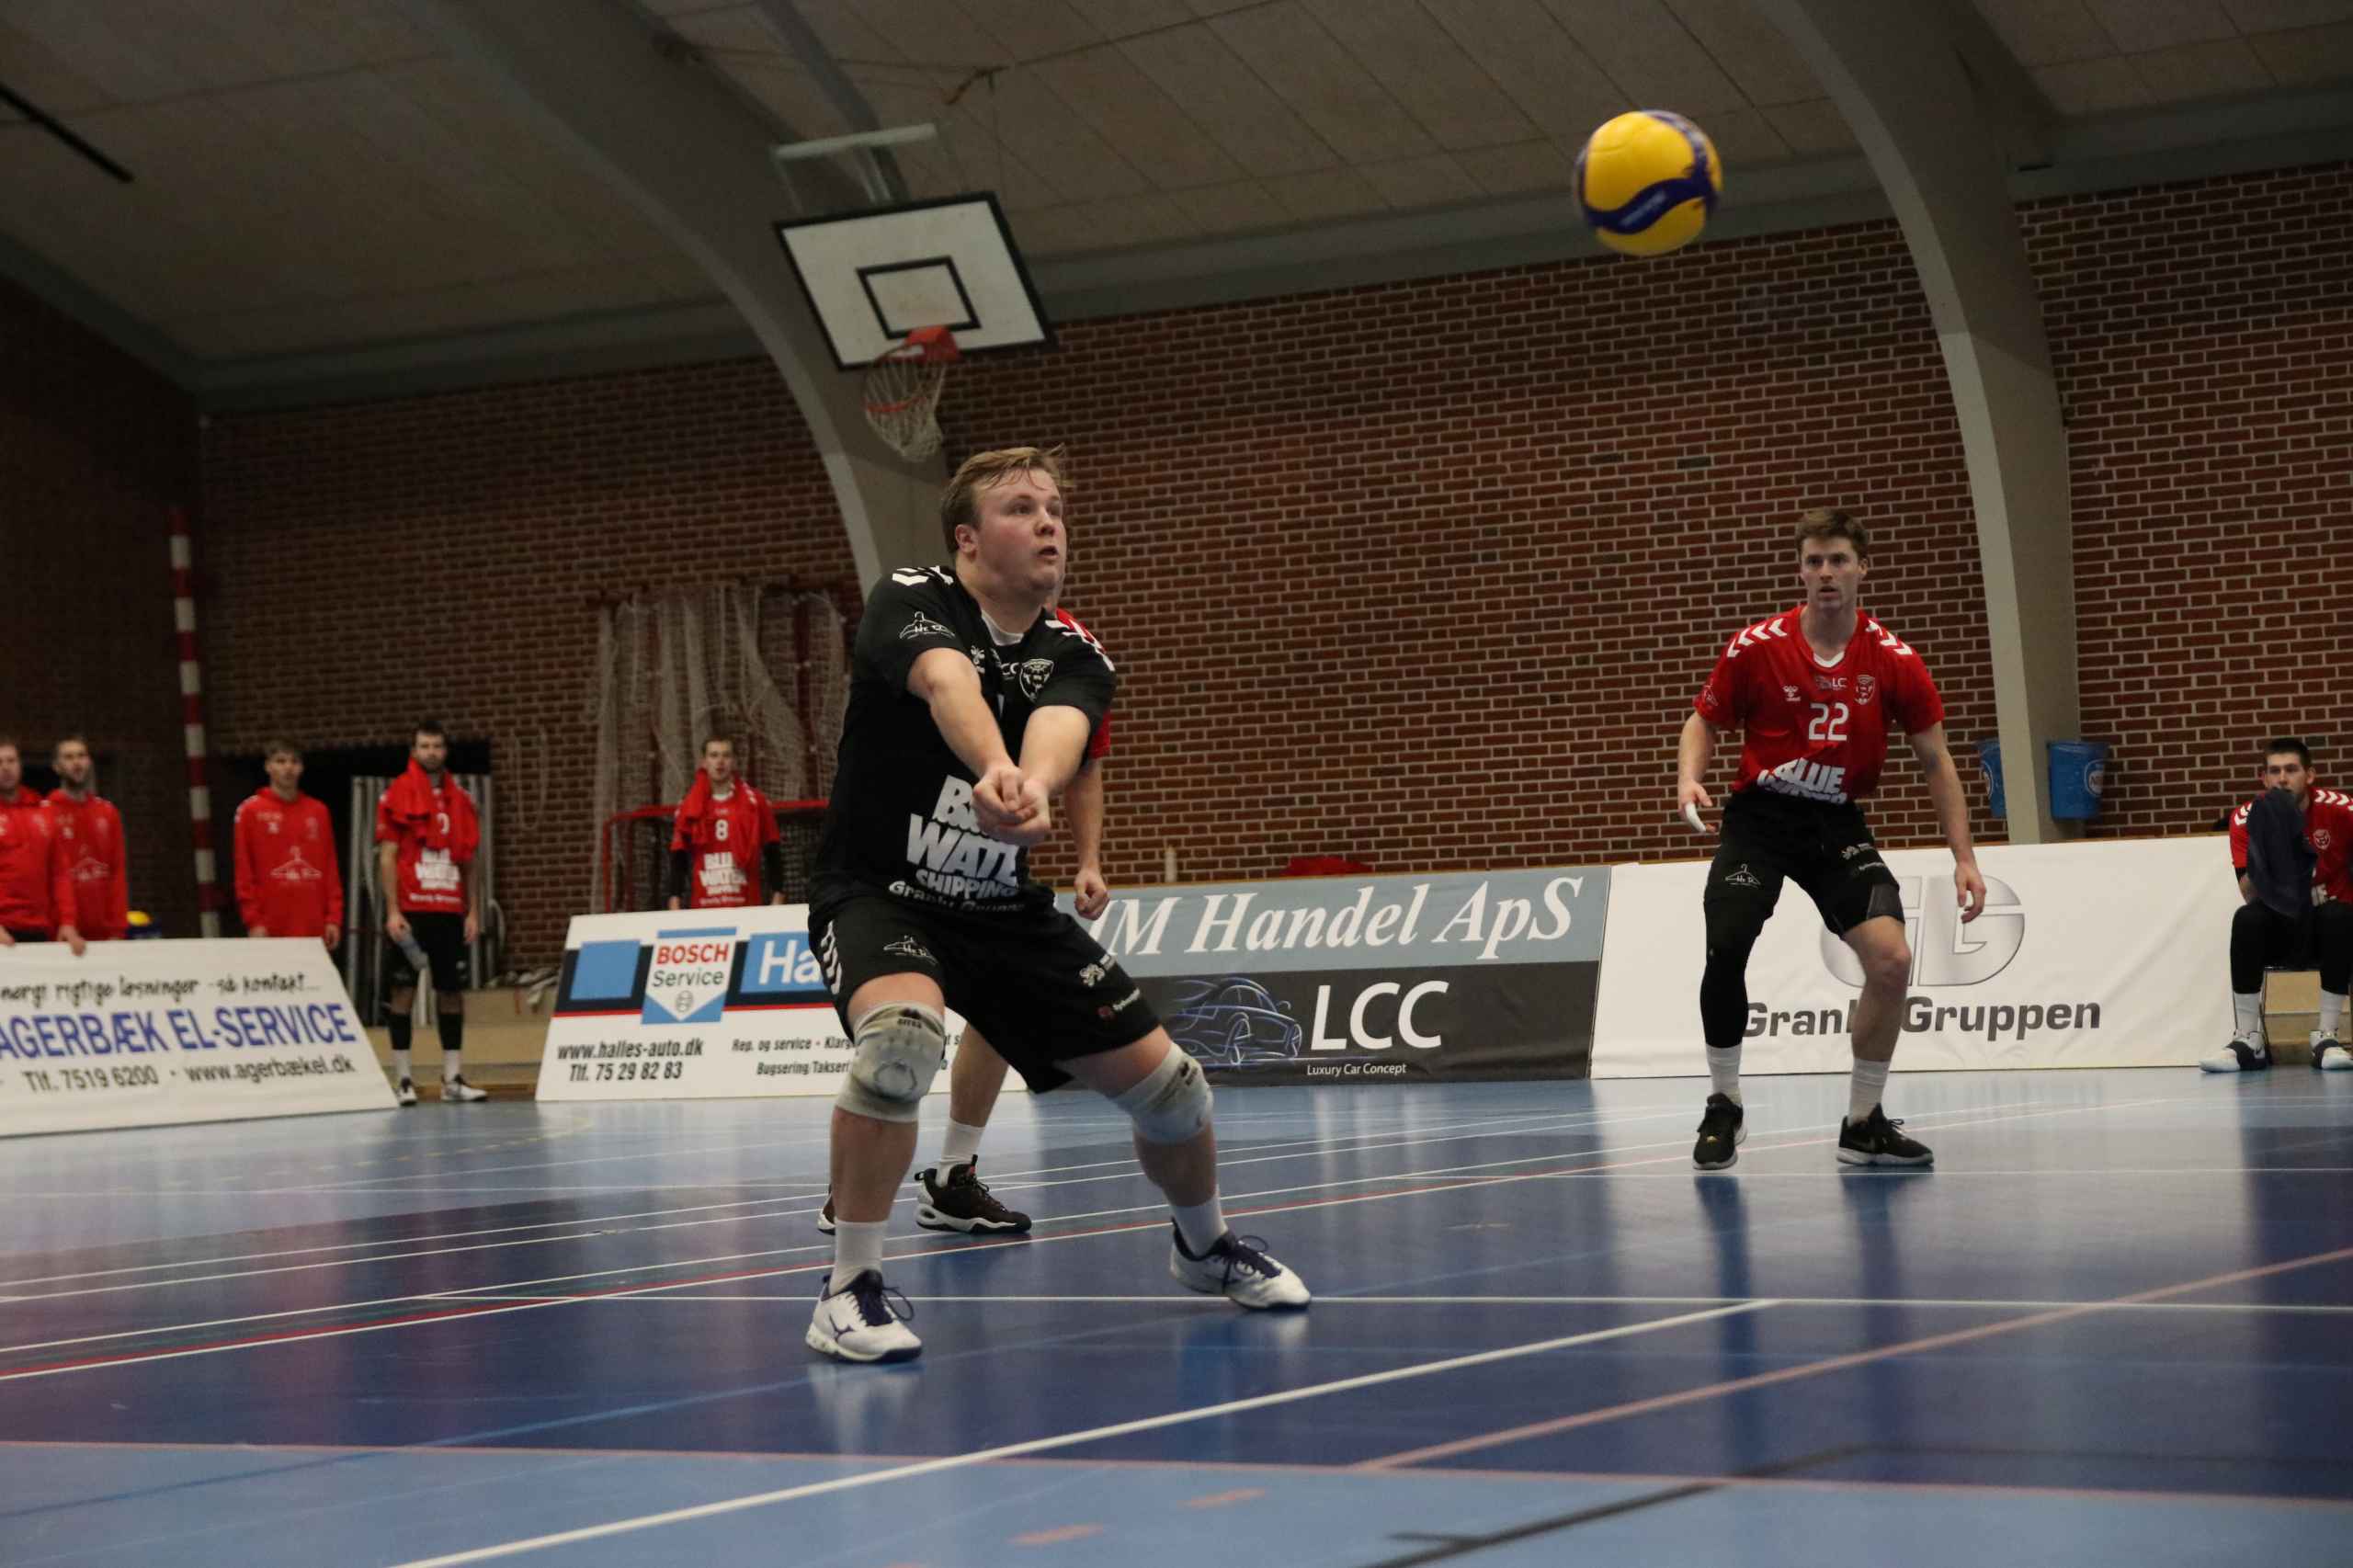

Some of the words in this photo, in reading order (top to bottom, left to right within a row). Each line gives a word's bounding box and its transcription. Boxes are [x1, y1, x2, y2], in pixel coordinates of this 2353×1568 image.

[1808, 702, 1849, 741] 22
[715, 818, 729, 841] 8
[1184, 883, 1432, 954] Handel
[1431, 876, 1584, 960] ApS
[656, 943, 729, 964] BOSCH
[653, 967, 723, 987] Service
[167, 1003, 357, 1050] EL-SERVICE
[1311, 981, 1449, 1051] LCC
[1900, 995, 2100, 1041] Gruppen
[557, 1038, 703, 1060] www.halles-auto.dk
[757, 1040, 771, 1052] og
[773, 1038, 812, 1051] service
[824, 1036, 850, 1050] Klarg
[60, 1067, 109, 1089] 7519
[111, 1064, 159, 1086] 6200
[596, 1062, 614, 1081] 75
[618, 1062, 637, 1080] 29
[641, 1061, 660, 1080] 82
[664, 1061, 683, 1079] 83
[1307, 1064, 1343, 1077] Luxury
[1344, 1063, 1361, 1074] Car
[1363, 1062, 1407, 1075] Concept
